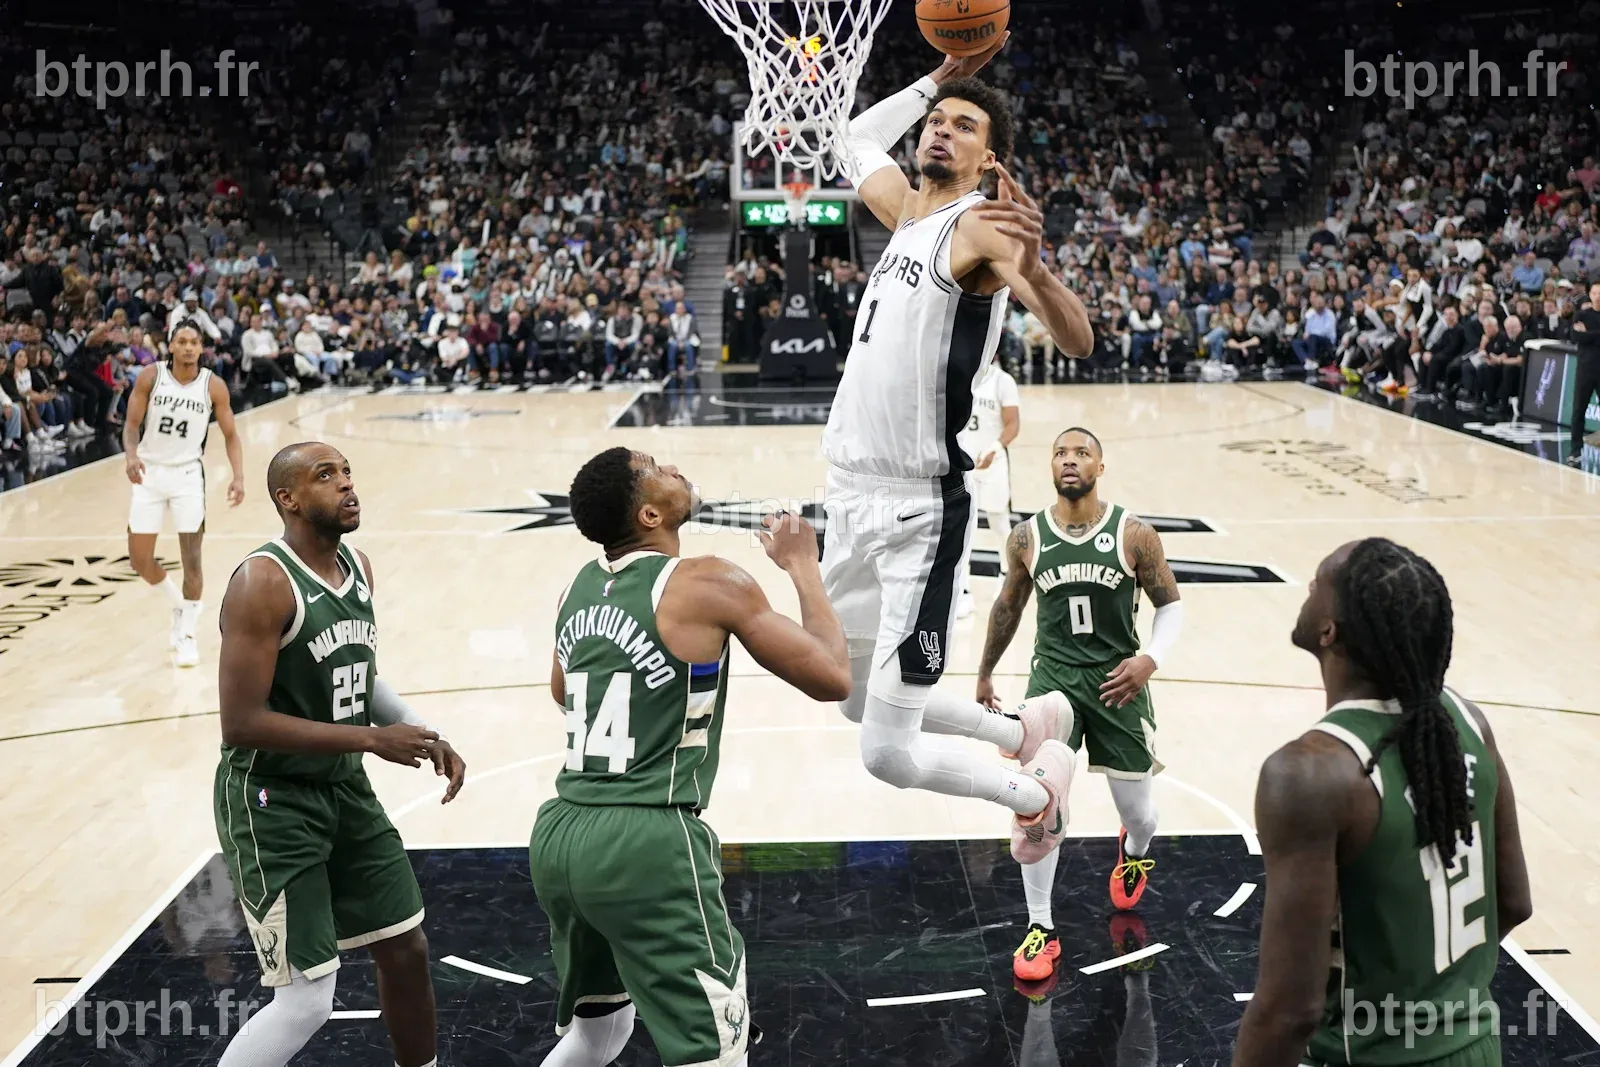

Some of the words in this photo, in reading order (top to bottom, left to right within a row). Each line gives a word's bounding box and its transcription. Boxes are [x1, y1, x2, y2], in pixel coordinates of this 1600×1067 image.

[934, 21, 997, 43] Wilson
[858, 299, 879, 344] 1
[154, 395, 205, 414] SPURS
[159, 416, 189, 438] 24
[969, 415, 979, 431] 3
[1036, 563, 1124, 594] MILWAUKEE
[1068, 595, 1094, 635] 0
[332, 661, 369, 722] 22
[565, 671, 635, 774] 34
[1419, 820, 1487, 974] 12
